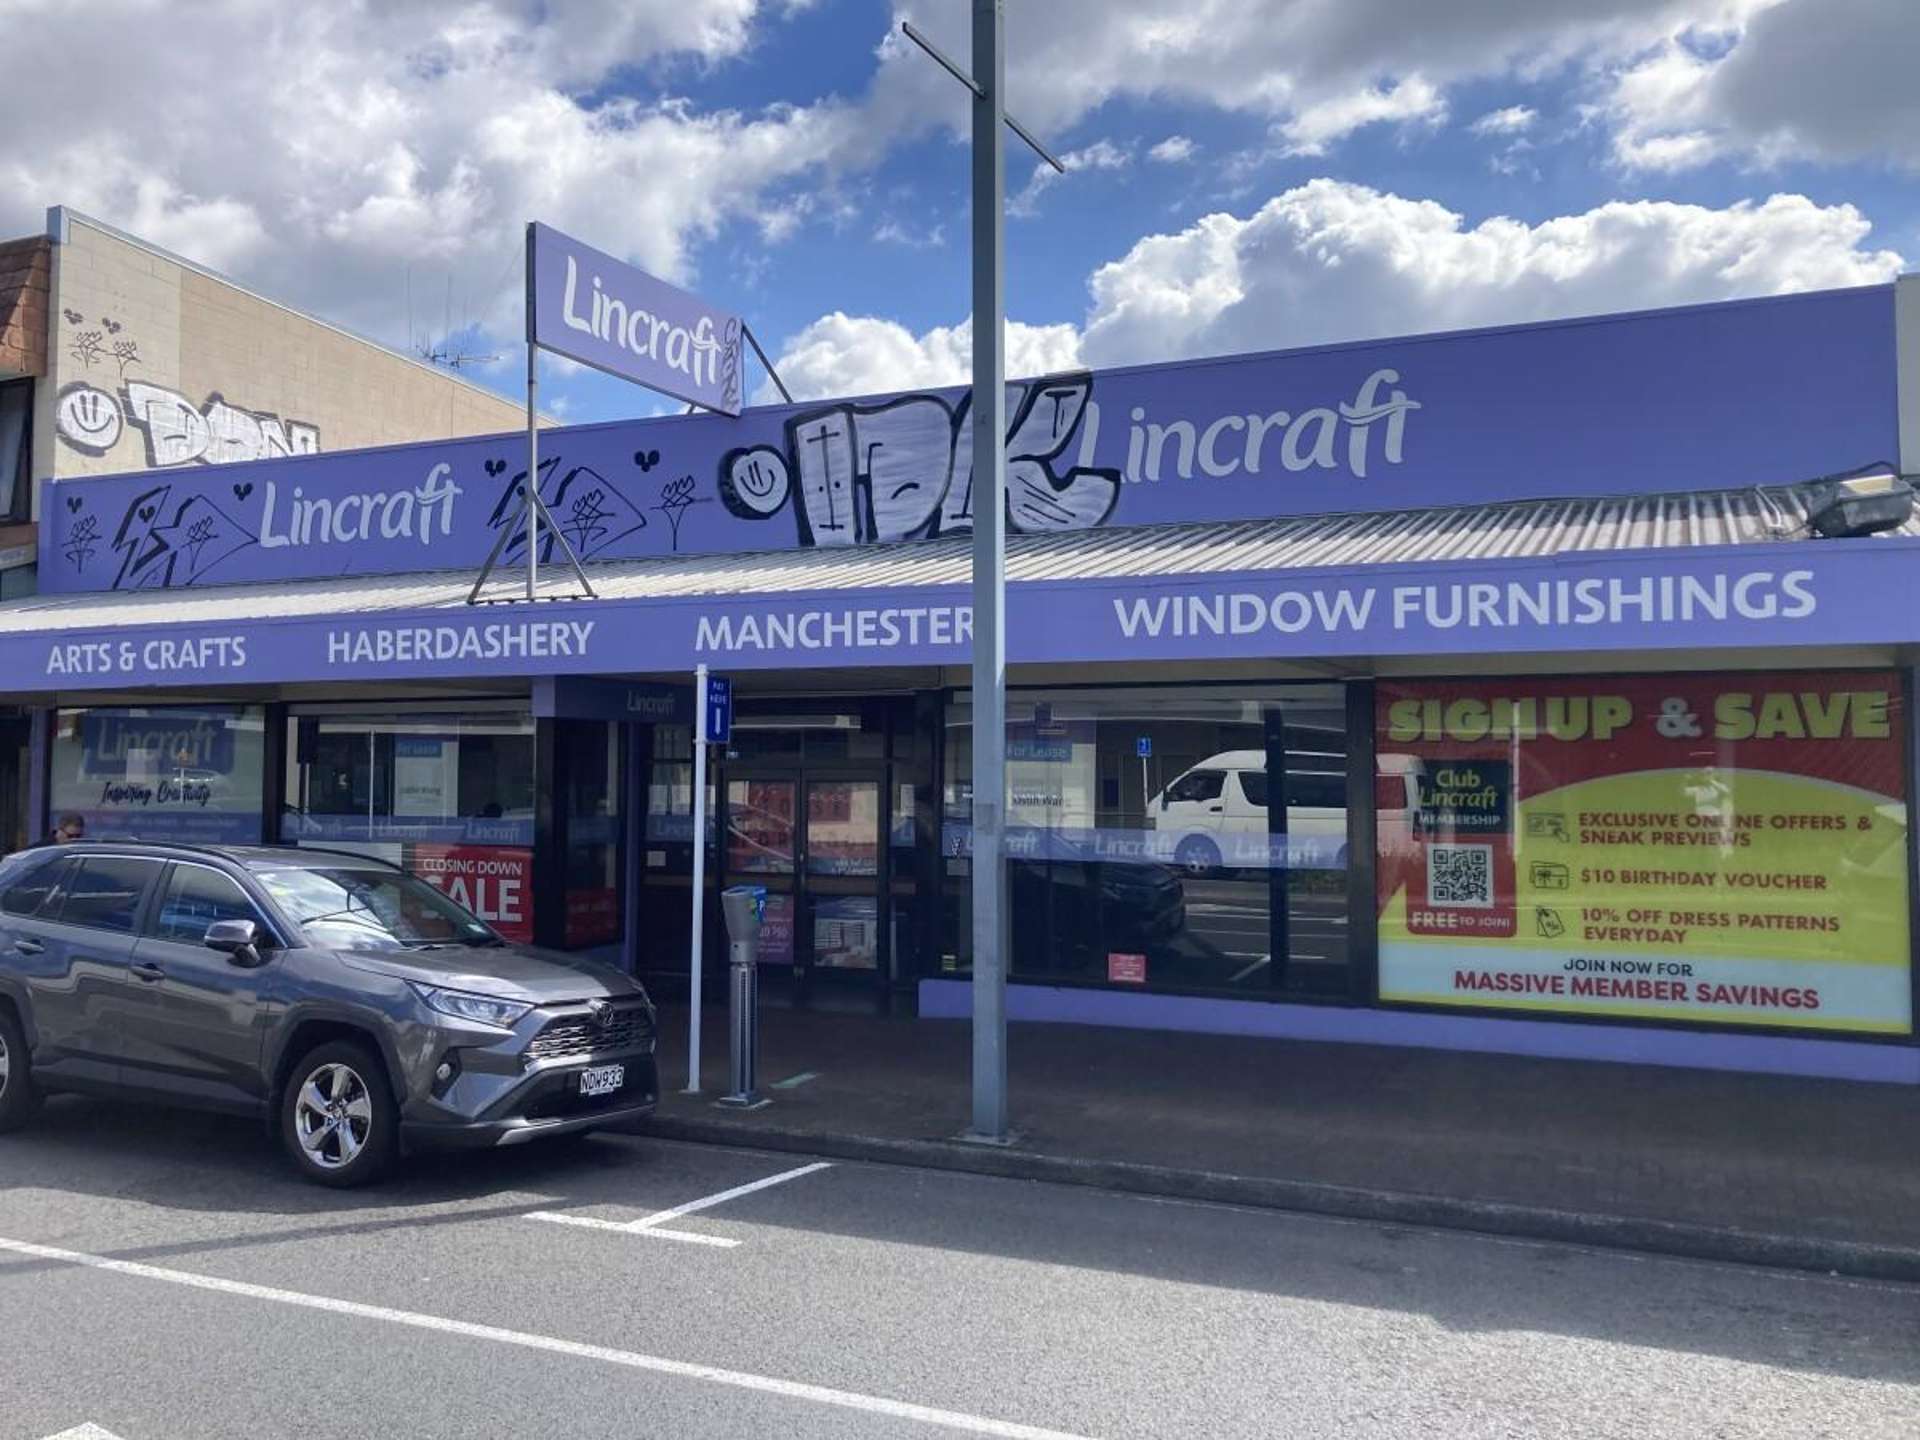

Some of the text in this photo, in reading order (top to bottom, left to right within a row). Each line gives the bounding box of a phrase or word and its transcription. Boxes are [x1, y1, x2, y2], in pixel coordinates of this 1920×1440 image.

[563, 255, 722, 388] Lincraft
[1078, 368, 1421, 484] Lincraft
[260, 462, 463, 548] Lincraft
[1113, 570, 1817, 637] WINDOW FURNISHINGS
[695, 606, 974, 651] MANCHESTER
[328, 621, 595, 663] HABERDASHERY
[46, 636, 246, 674] ARTS & CRAFTS
[1546, 695, 1633, 741] UP
[1656, 697, 1702, 738] &
[1714, 691, 1891, 740] SAVE
[99, 717, 216, 767] Lincraft
[1436, 769, 1480, 789] Club
[1419, 786, 1498, 810] Lincraft
[1420, 813, 1501, 825] MEMBERSHIP
[1579, 813, 1873, 830] EXCLUSIVE ONLNE OFFERS &
[1580, 829, 1645, 844] SNEAK
[423, 859, 522, 876] CLOSING DOWN
[1581, 869, 1827, 889] $10 BIRTHDAY VOUCHER
[1411, 911, 1458, 928] FREE
[1582, 908, 1841, 932] 10% OFF DRESS PATTERNS
[1584, 926, 1687, 943] EVERYDAY
[1564, 959, 1694, 977] JOIN NOW FOR
[1455, 971, 1820, 1009] MASSIVE MEMBER SAVINGS
